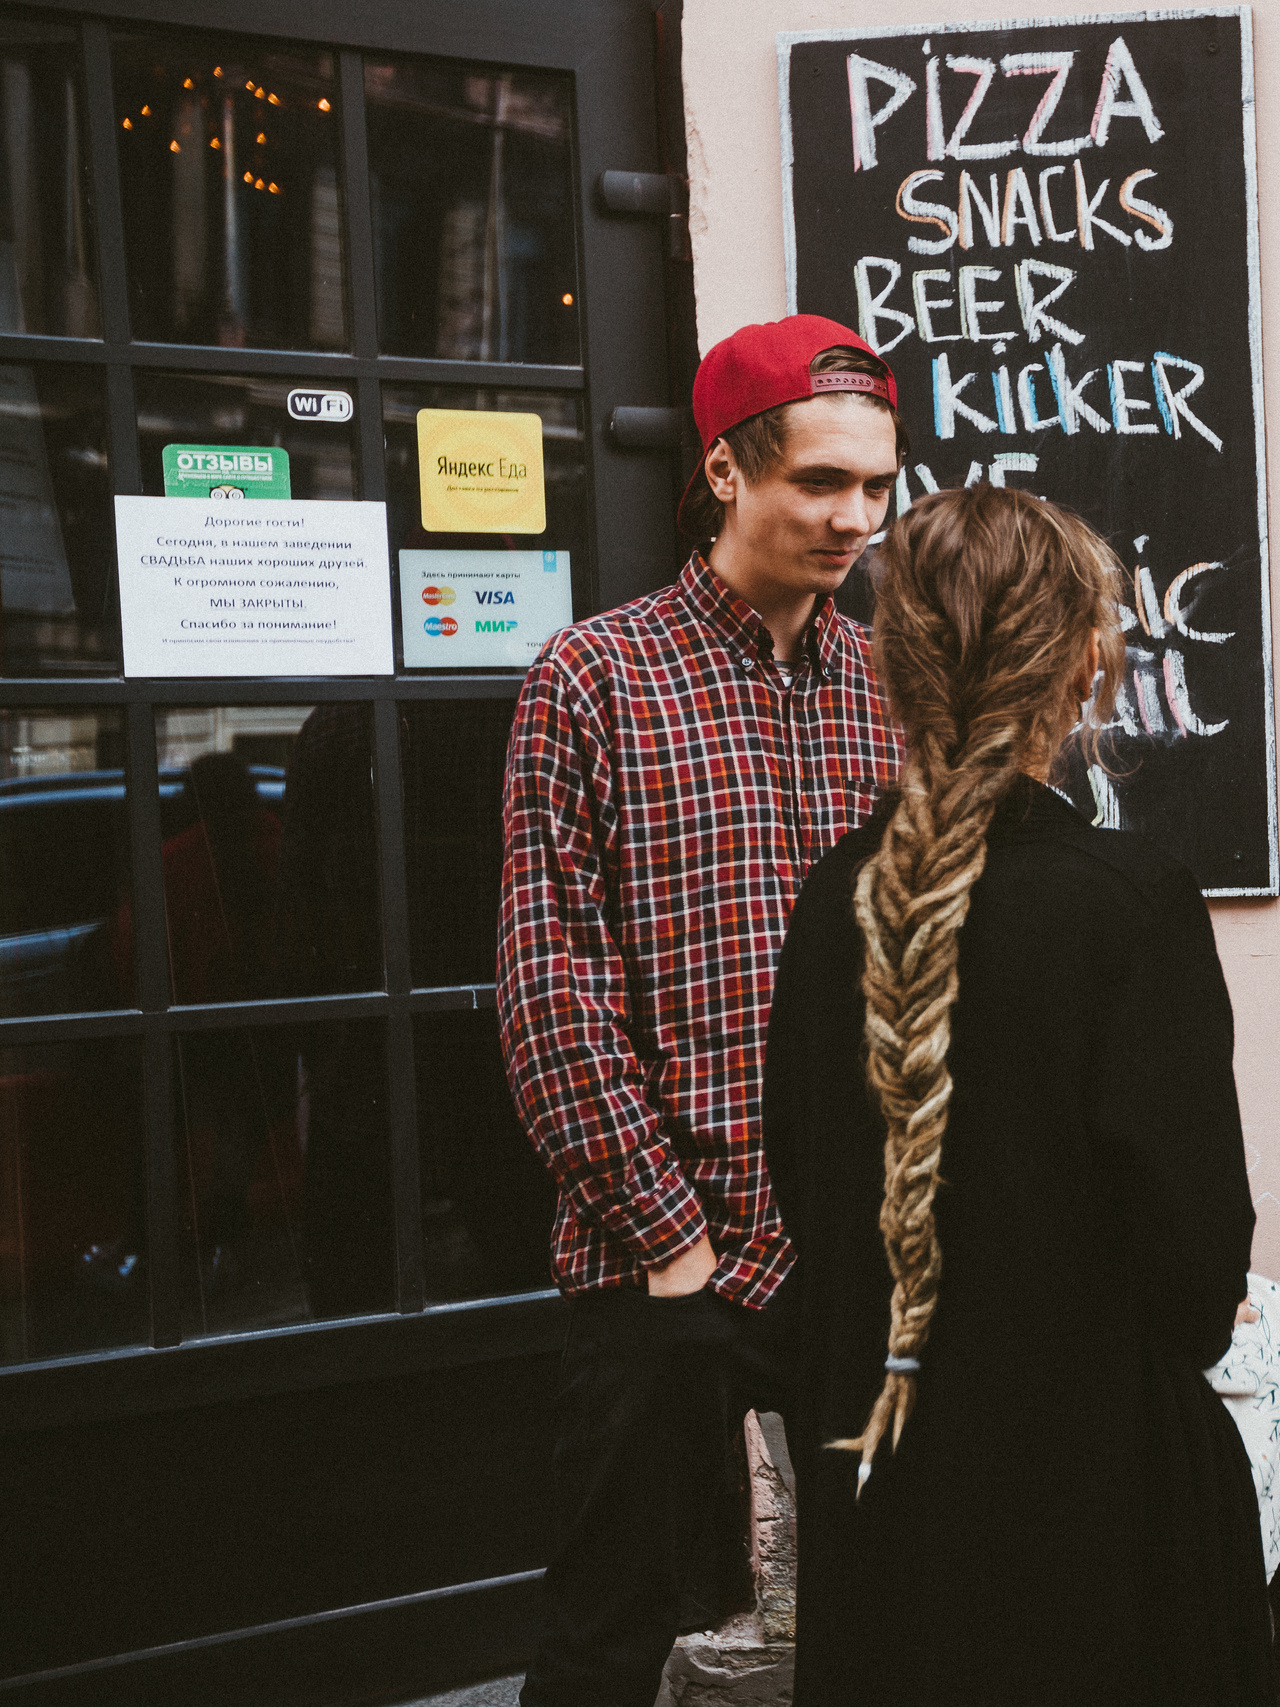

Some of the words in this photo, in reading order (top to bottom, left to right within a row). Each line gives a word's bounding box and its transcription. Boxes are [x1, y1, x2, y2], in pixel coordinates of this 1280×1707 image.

[854, 256, 1085, 355] BEER
[177, 453, 272, 472] ОТЗЫВЫ
[437, 455, 494, 478] Яндекс
[499, 457, 527, 479] Еда
[204, 516, 262, 528] Дорогие
[266, 516, 305, 528] гости!
[156, 536, 217, 549] Сегодня,
[221, 539, 229, 548] в
[232, 539, 279, 548] нашем
[283, 540, 352, 551] заведении
[140, 555, 206, 567] СВАДЬБА
[209, 557, 253, 567] наших
[257, 558, 315, 569] хороших
[421, 571, 446, 579] Здесь
[447, 571, 494, 579] принимают
[174, 577, 183, 587] К
[186, 579, 256, 589] огромном
[260, 579, 340, 590] сожалению,
[210, 598, 235, 608] МЫ
[474, 590, 515, 605] VISA
[180, 618, 237, 630] Спасибо
[242, 621, 254, 630] за
[258, 620, 337, 631] понимание!
[424, 620, 458, 633] Maestro
[475, 620, 518, 632] МИР
